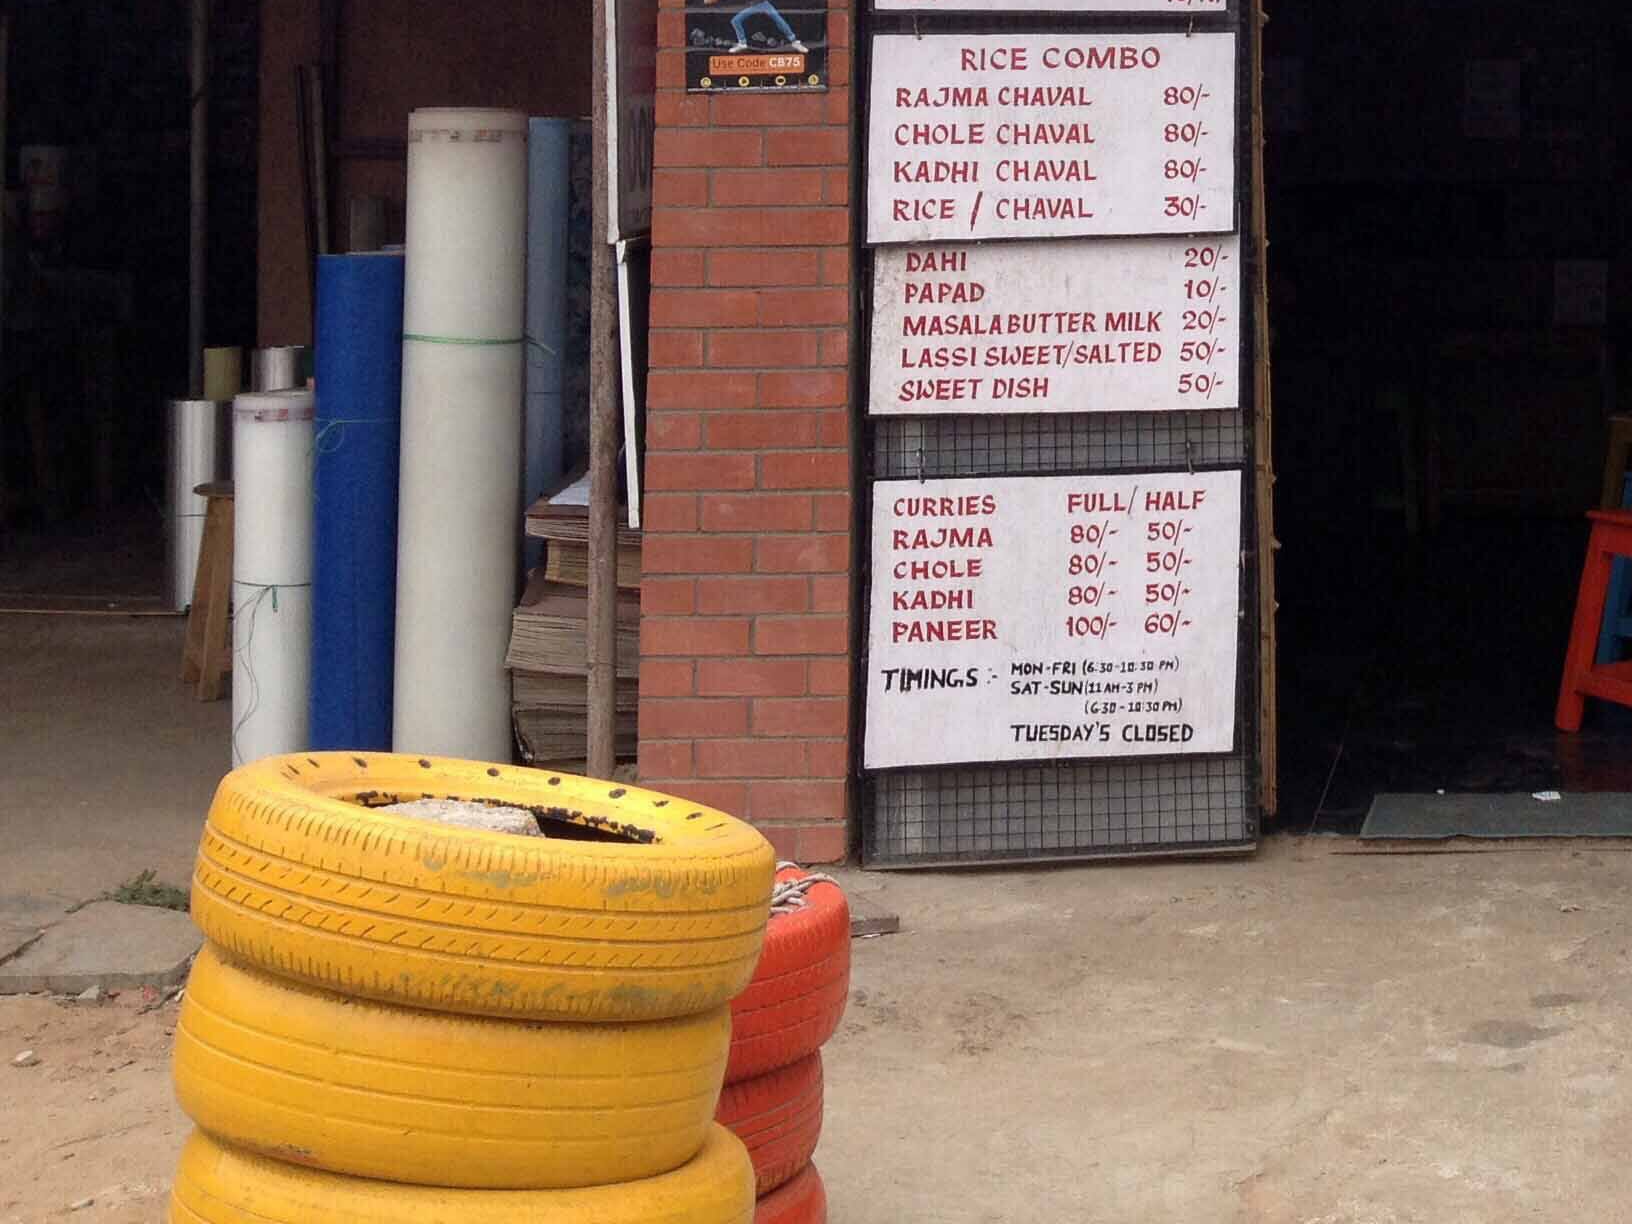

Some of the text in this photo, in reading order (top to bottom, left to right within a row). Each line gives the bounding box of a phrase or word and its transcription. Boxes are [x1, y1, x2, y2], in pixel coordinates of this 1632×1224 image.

[712, 56, 800, 69] Use Code CB75
[961, 46, 1161, 71] RICE COMBO
[896, 83, 1210, 111] RAJMA CHAVAL 80/-
[894, 120, 1208, 147] CHOLE CHAVAL 80/-
[893, 157, 1207, 184] KADHI CHAVAL 80/-
[892, 194, 1207, 222] RICE CHAVAL 30/-
[906, 244, 1229, 272] DAHI 20/-
[904, 276, 1227, 304] PAPAD 10/-
[903, 305, 1227, 337] MASALA BUTTER MILK 20/-
[901, 346, 976, 369] LASSI
[1179, 336, 1225, 364] 50/-
[898, 372, 1224, 402] SWEET DISH 50/-
[893, 495, 997, 517] CURRIES
[1144, 490, 1207, 511] HALF
[892, 519, 1193, 551] RAJMA 80/- 50/-
[893, 548, 1193, 580] CHOLE 80/- 50/-
[892, 577, 1192, 611] KADHI 80/- 50/-
[892, 610, 1192, 643] PANEER 100/- 60/-
[881, 667, 979, 693] TIMINGS
[1010, 722, 1193, 742] TUESDAY'S CLOSED
